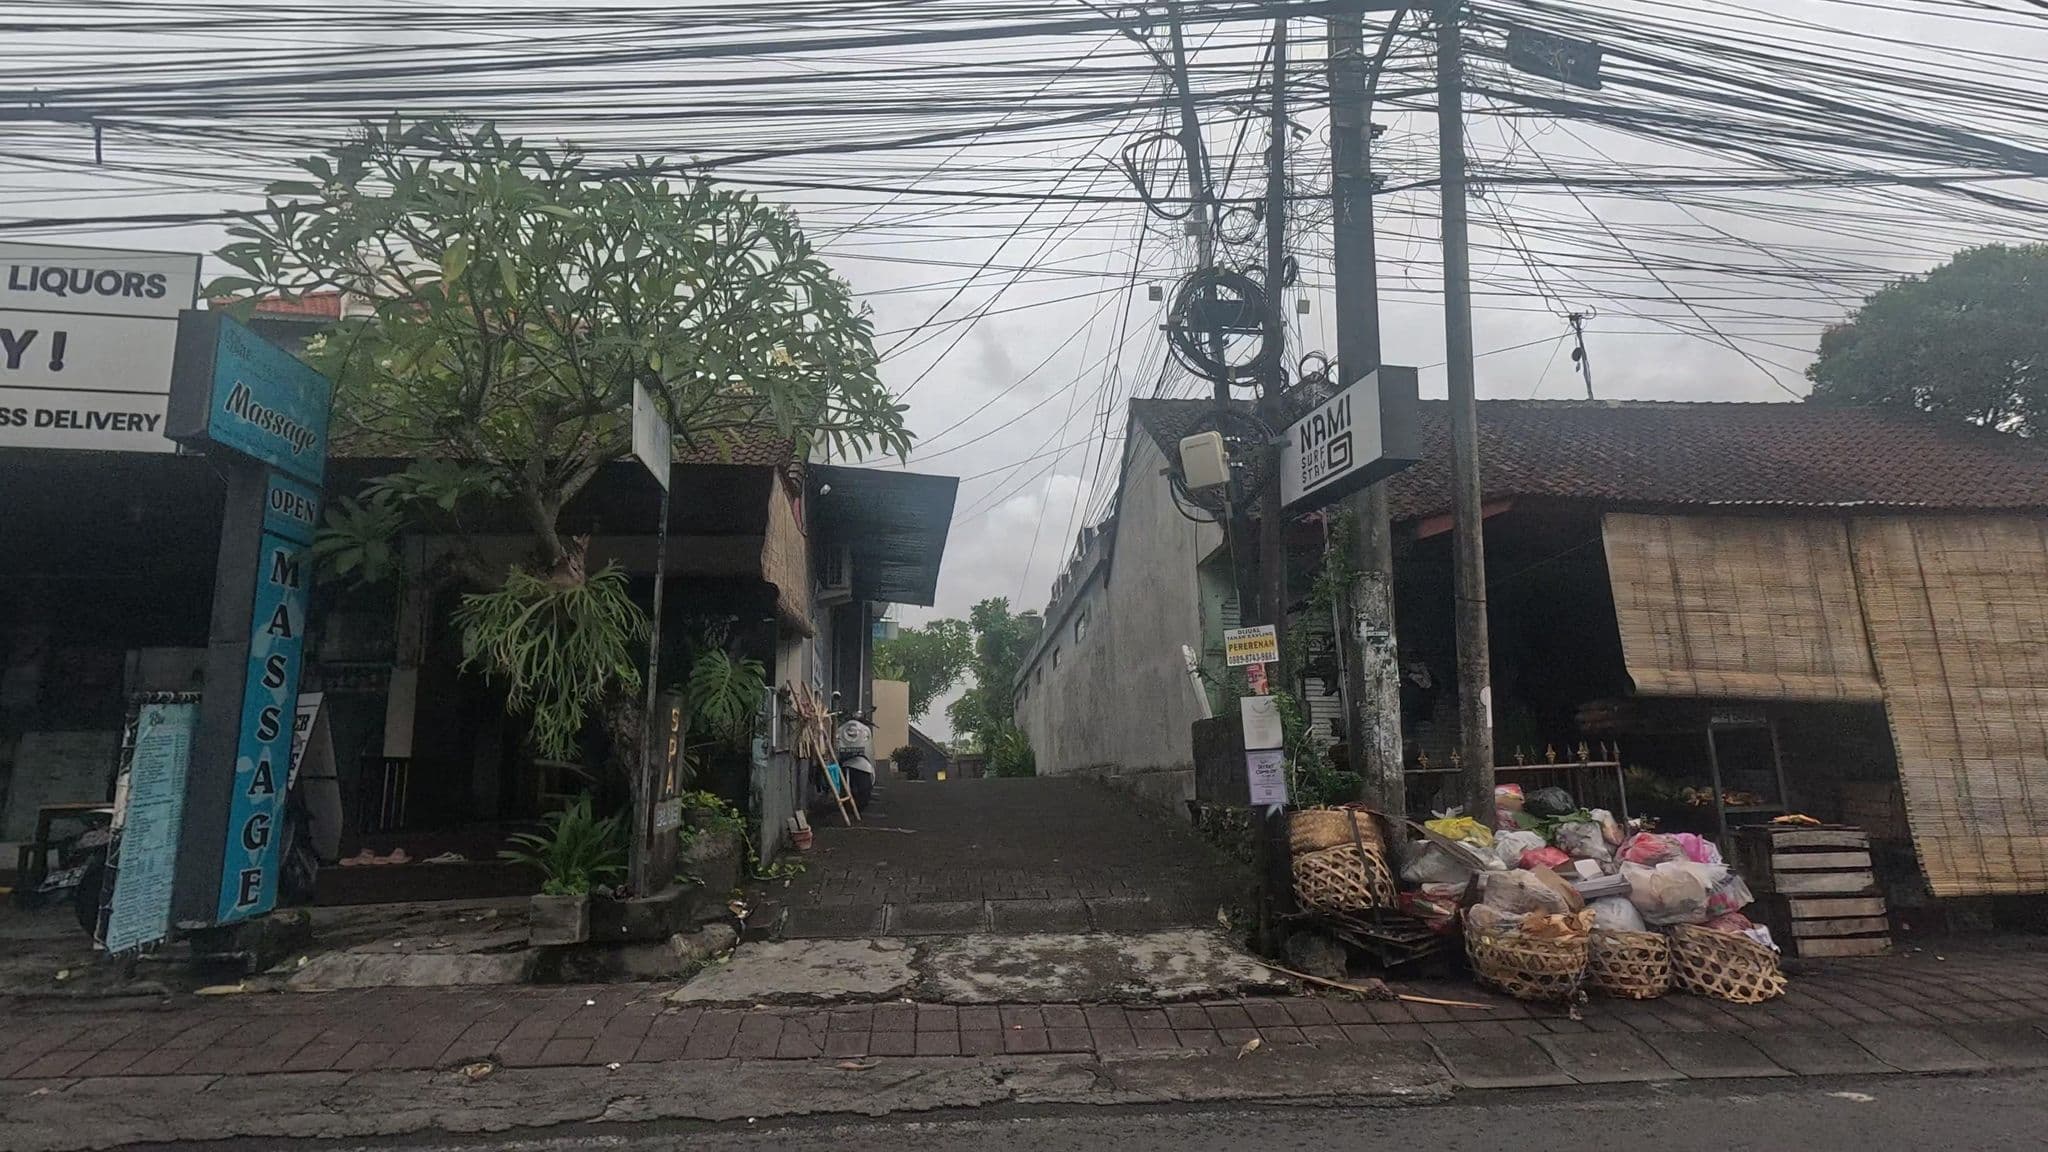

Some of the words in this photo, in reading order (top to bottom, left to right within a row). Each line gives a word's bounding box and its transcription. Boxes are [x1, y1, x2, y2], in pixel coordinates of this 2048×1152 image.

[8, 264, 167, 298] LIQUORS
[34, 408, 161, 432] DELIVERY
[224, 381, 318, 454] Massage
[1300, 394, 1352, 453] NAMI
[1301, 446, 1326, 469] SURF
[1301, 460, 1326, 484] STAY
[271, 486, 316, 523] OPEN
[1228, 640, 1275, 652] PERERENAN
[237, 549, 300, 907] MASSAGE
[665, 706, 680, 794] SPA
